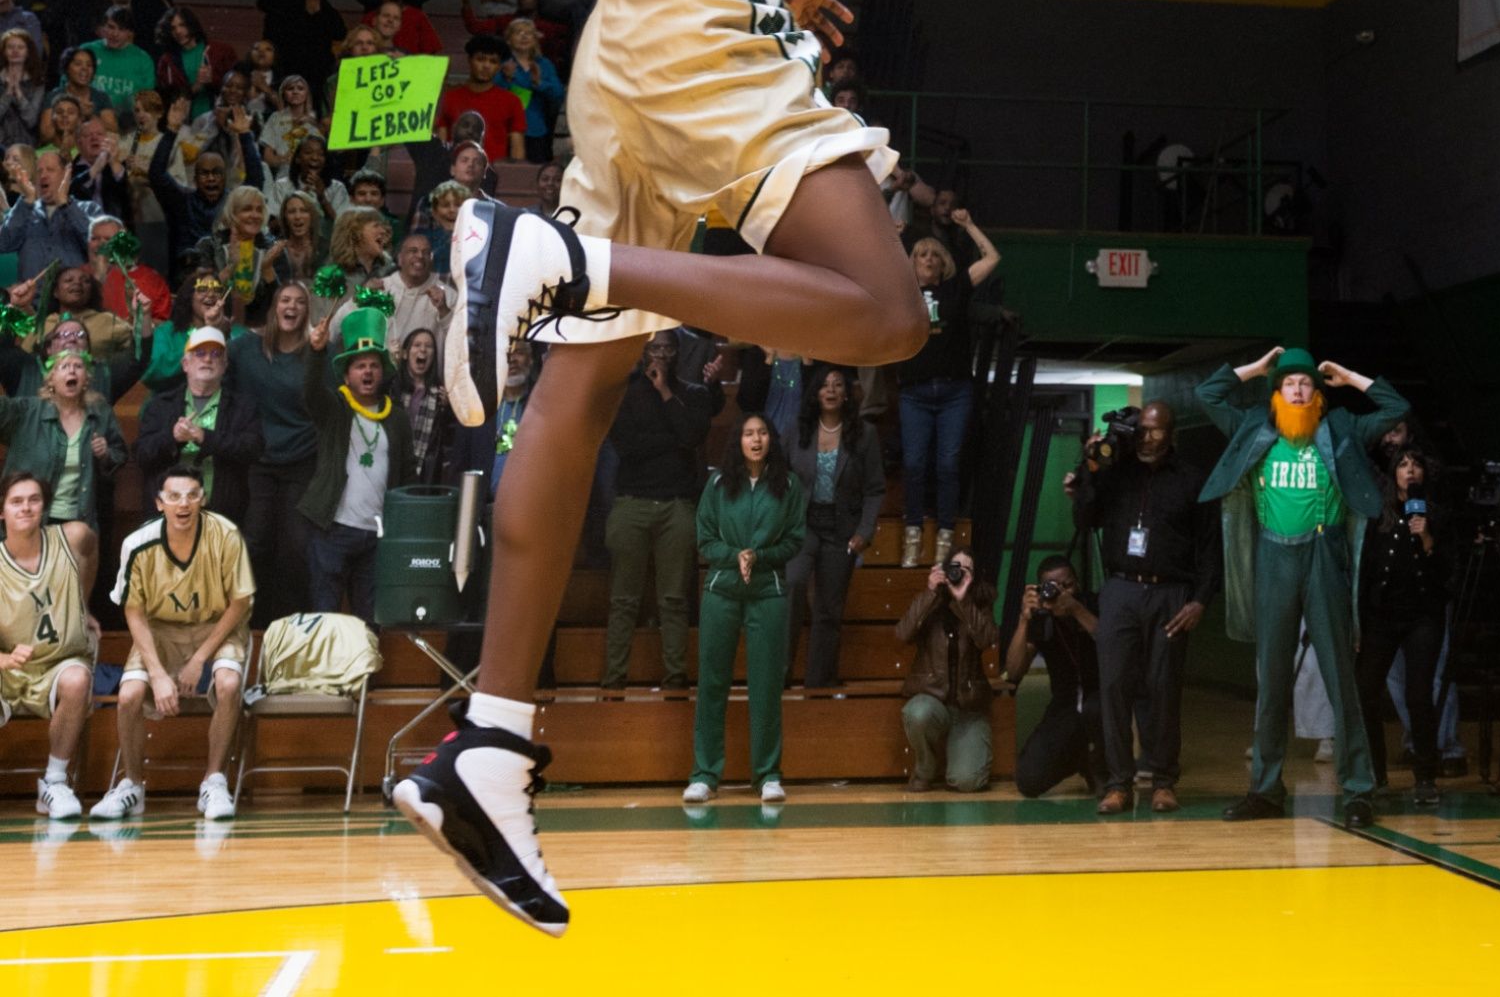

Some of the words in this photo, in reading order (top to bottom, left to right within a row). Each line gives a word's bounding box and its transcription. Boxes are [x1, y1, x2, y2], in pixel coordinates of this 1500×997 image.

[95, 75, 134, 95] RISH
[348, 103, 433, 142] LEBRON
[1109, 252, 1141, 276] EXIT
[1270, 461, 1318, 489] IRISH
[36, 613, 60, 644] 4
